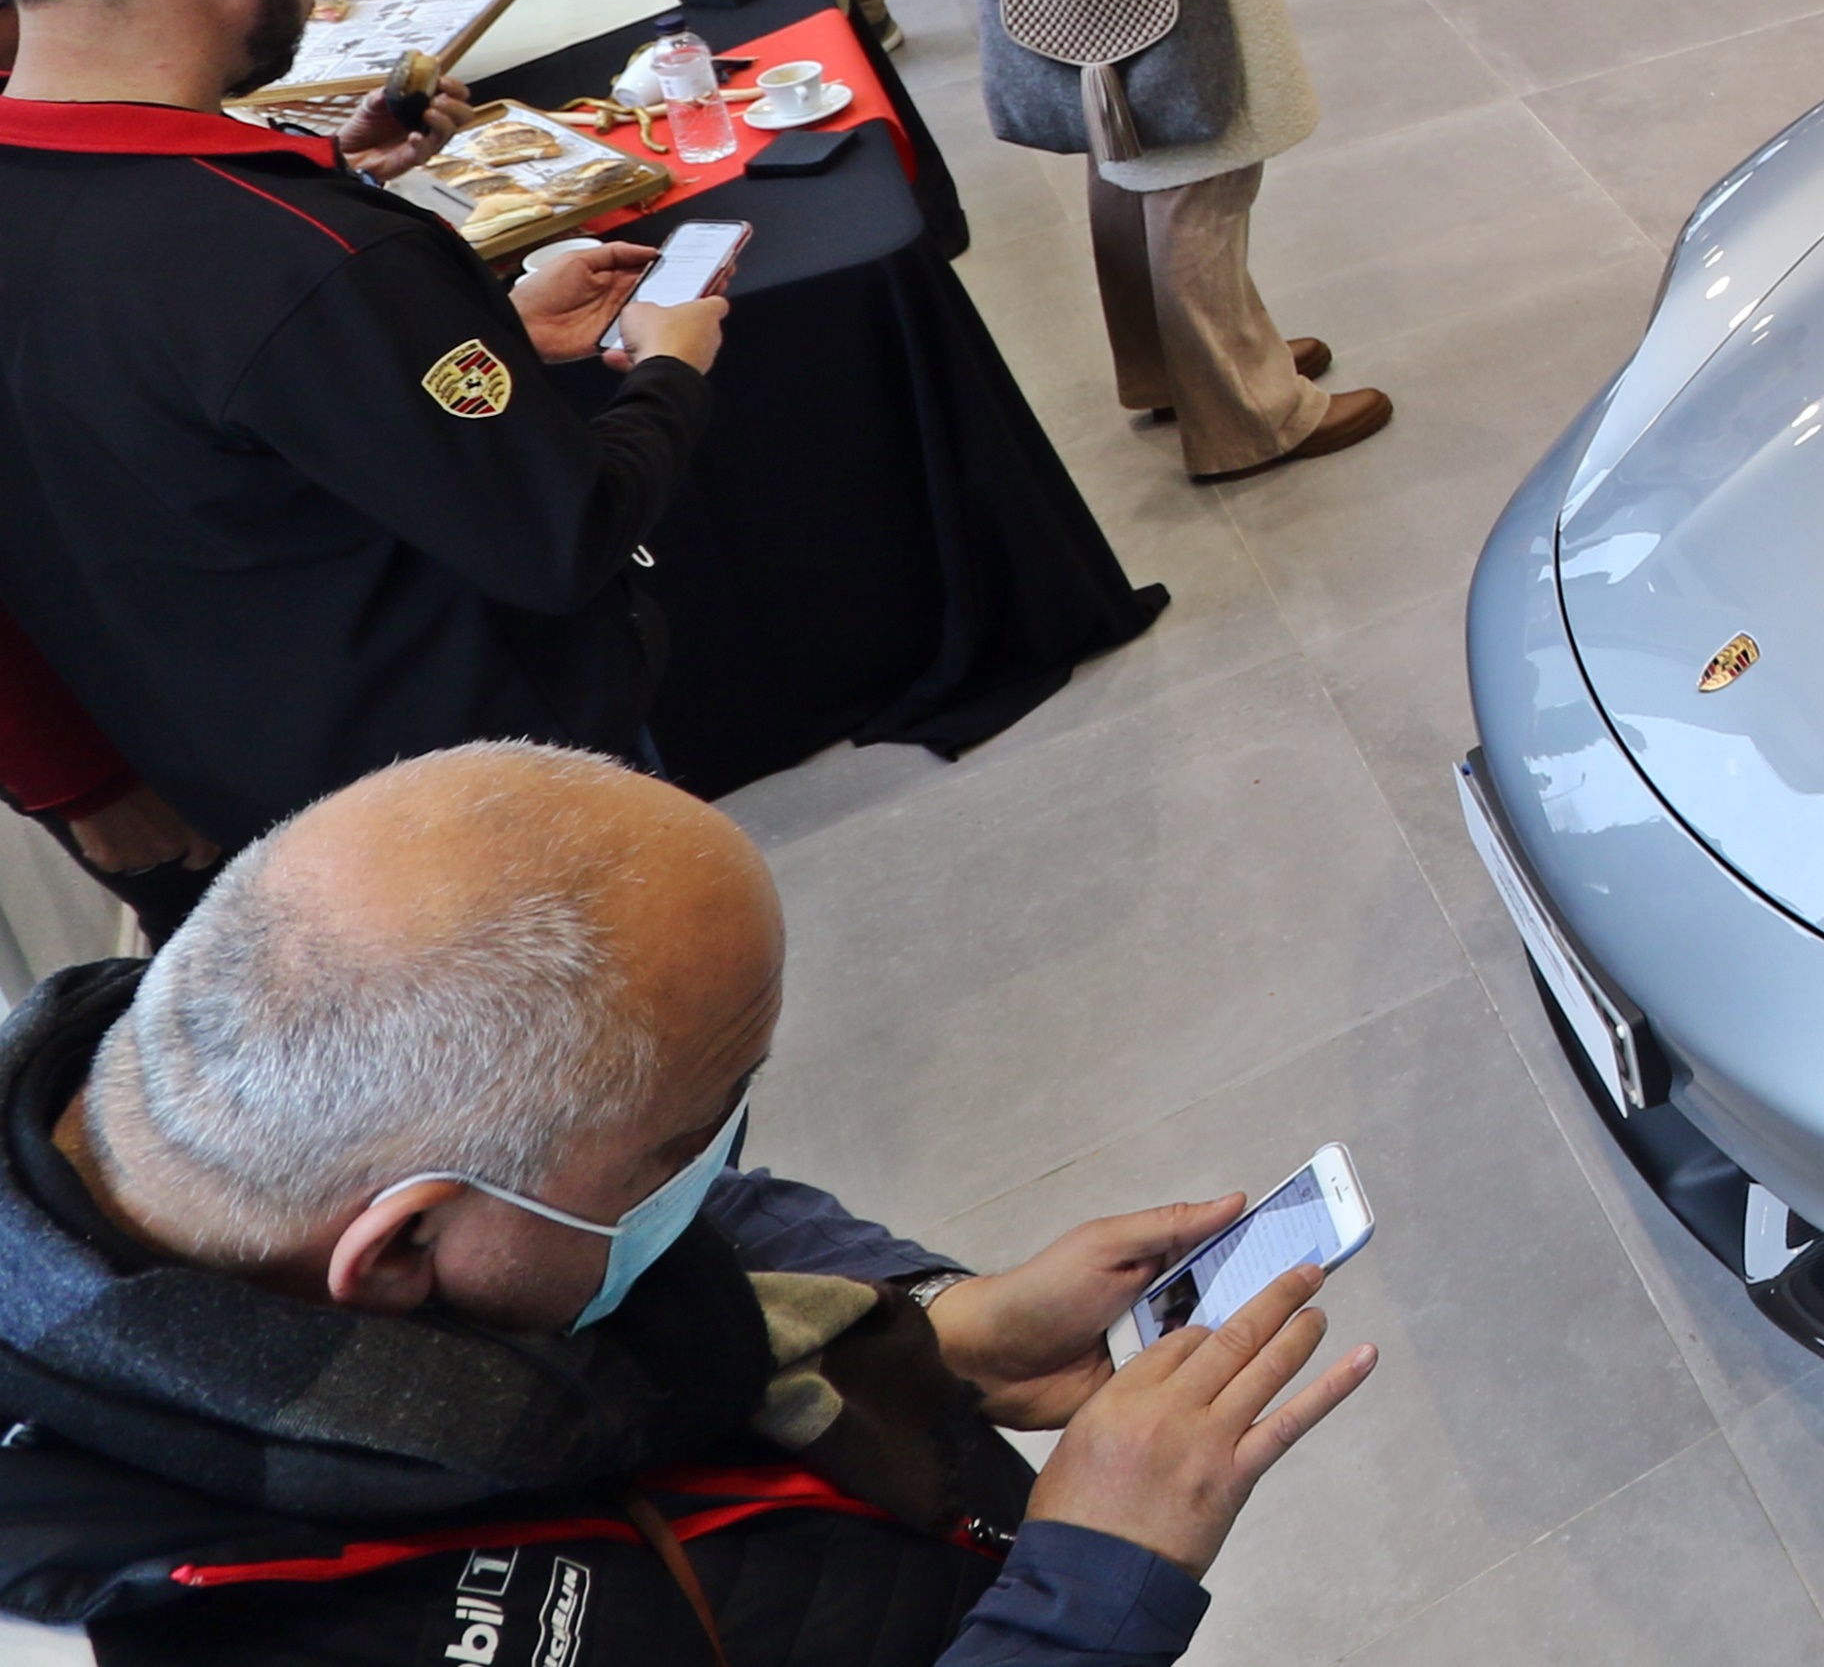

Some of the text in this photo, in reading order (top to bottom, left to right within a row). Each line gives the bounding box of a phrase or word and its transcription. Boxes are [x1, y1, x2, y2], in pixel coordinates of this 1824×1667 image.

[444, 1556, 510, 1667] bil 1
[543, 1565, 578, 1667] ICHELIN
